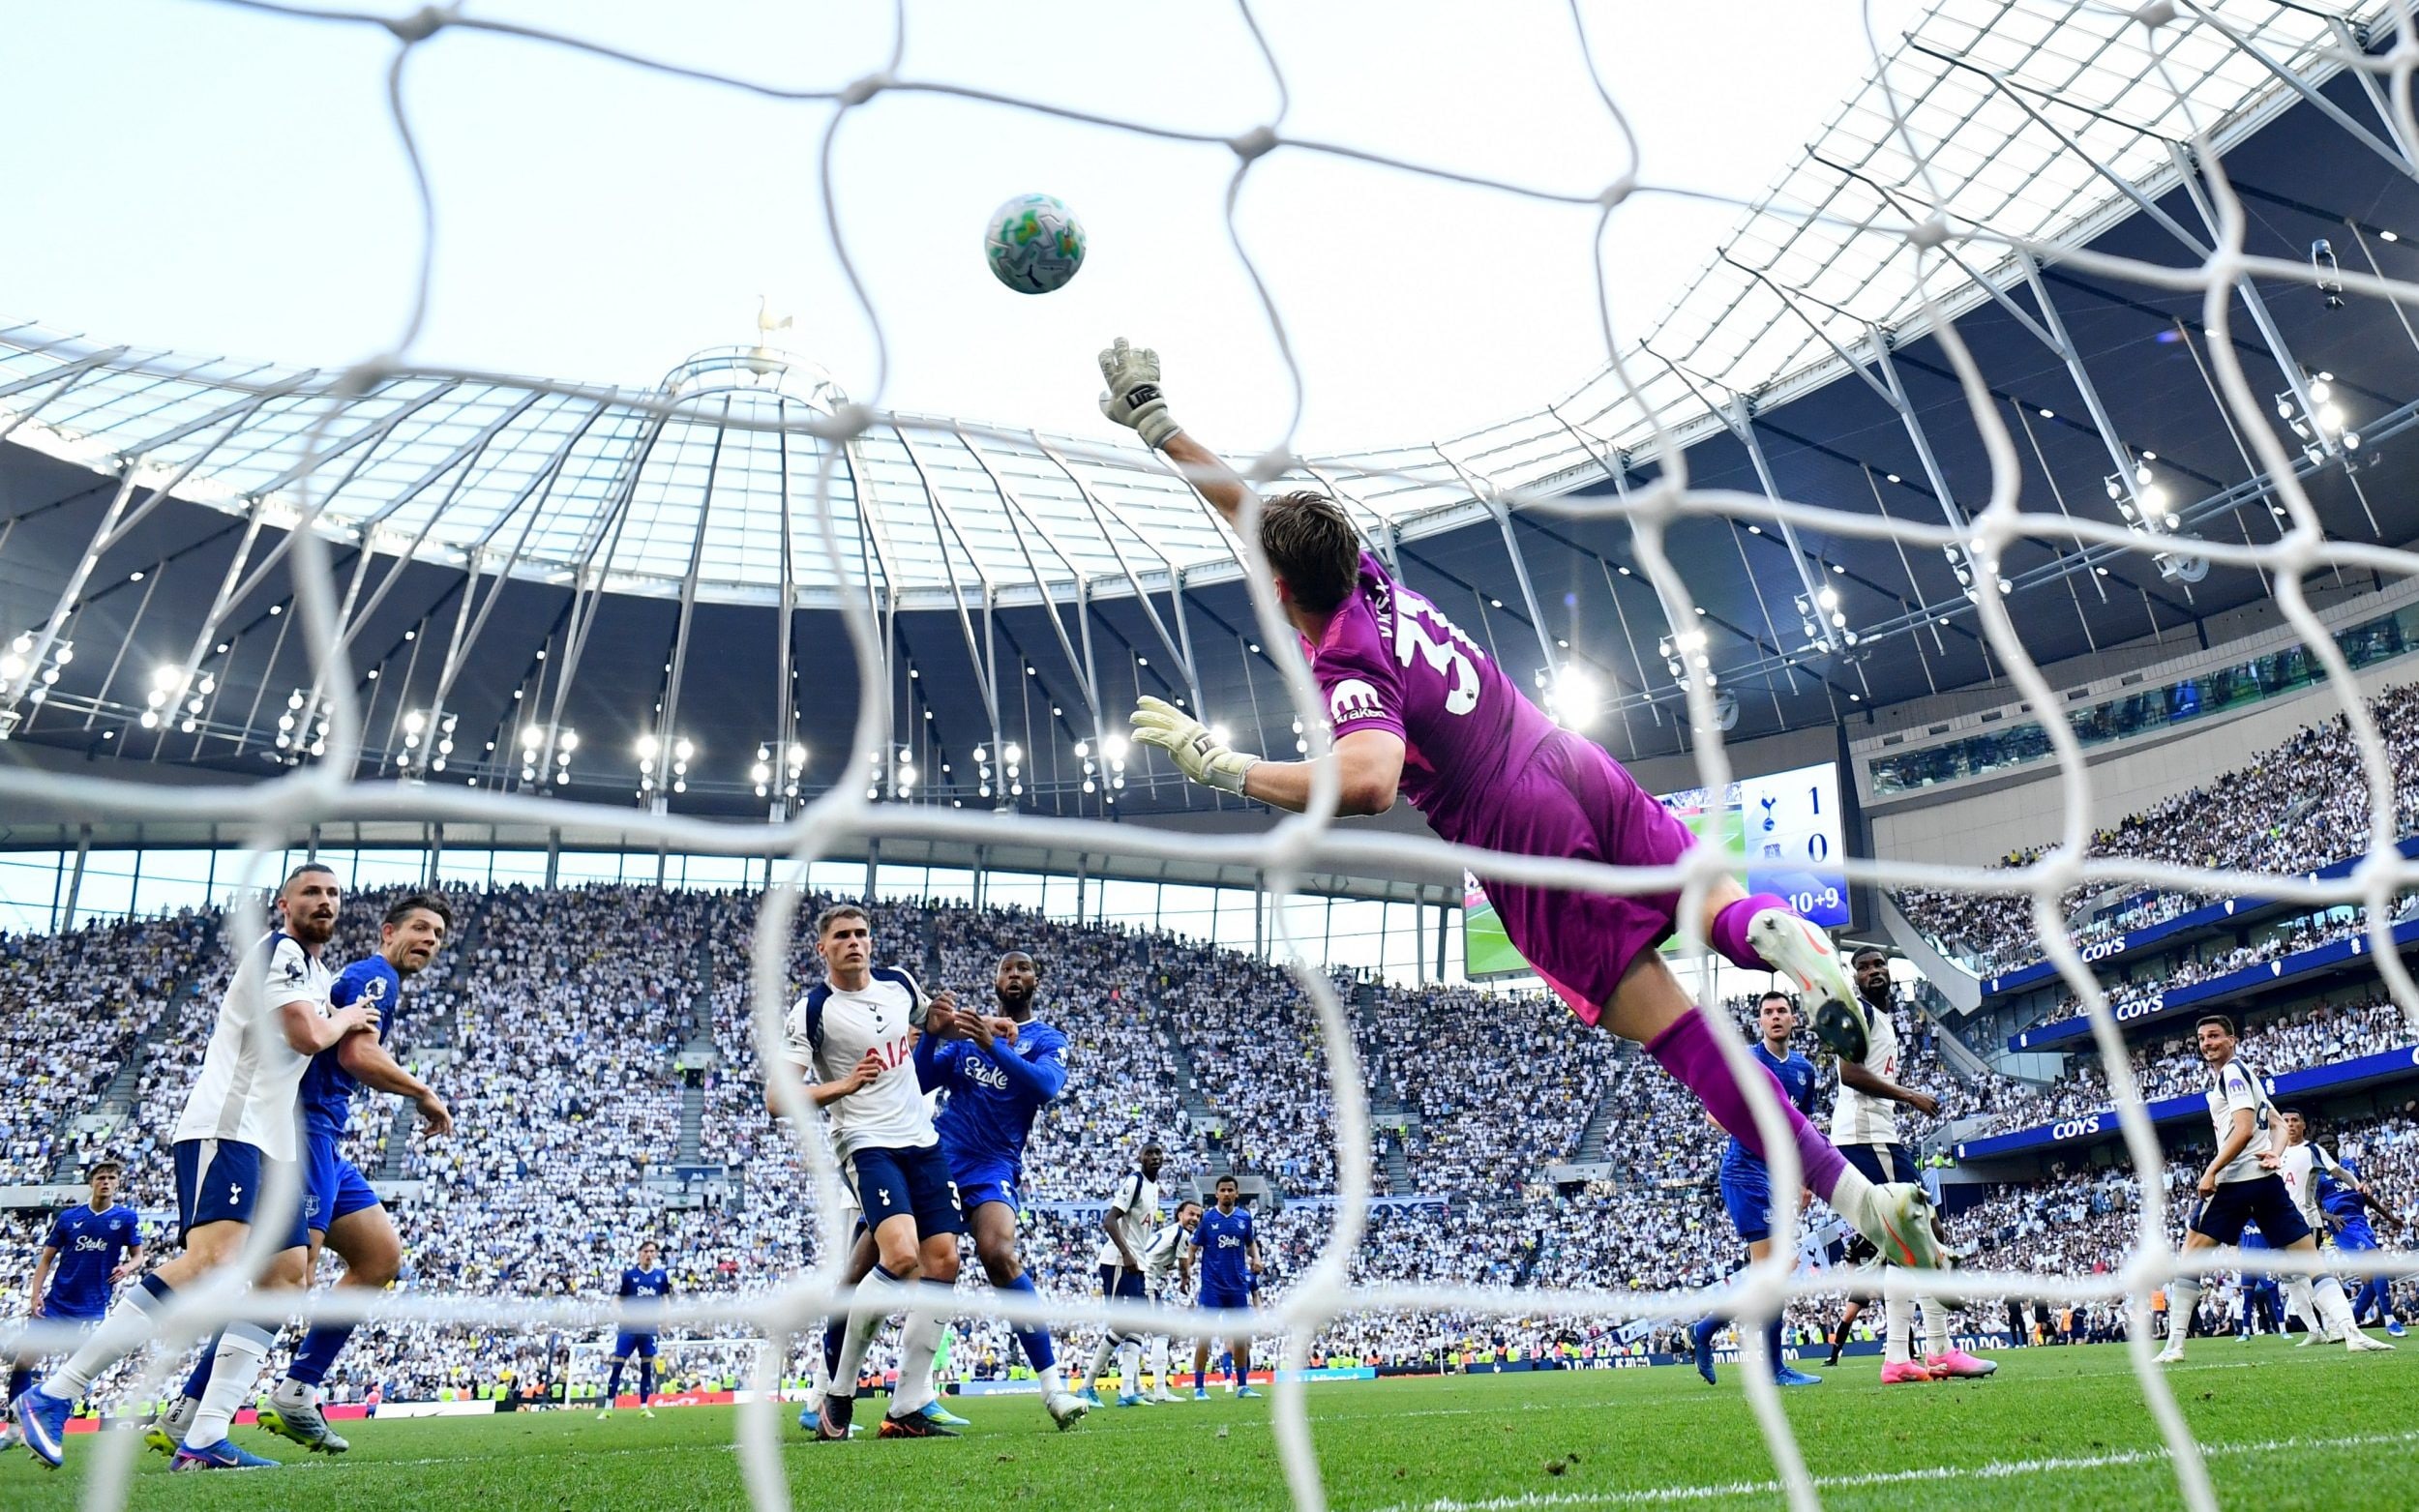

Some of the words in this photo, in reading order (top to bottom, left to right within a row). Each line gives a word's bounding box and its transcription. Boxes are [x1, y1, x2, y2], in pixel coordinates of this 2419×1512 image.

[1807, 786, 1819, 815] 1
[1807, 833, 1828, 863] 0
[1789, 886, 1839, 913] 10+9
[2081, 935, 2126, 964] COYS
[2116, 994, 2164, 1022] COYS
[965, 1056, 1008, 1090] Stake
[2052, 1115, 2100, 1141] COYS
[75, 1235, 107, 1252] Stake
